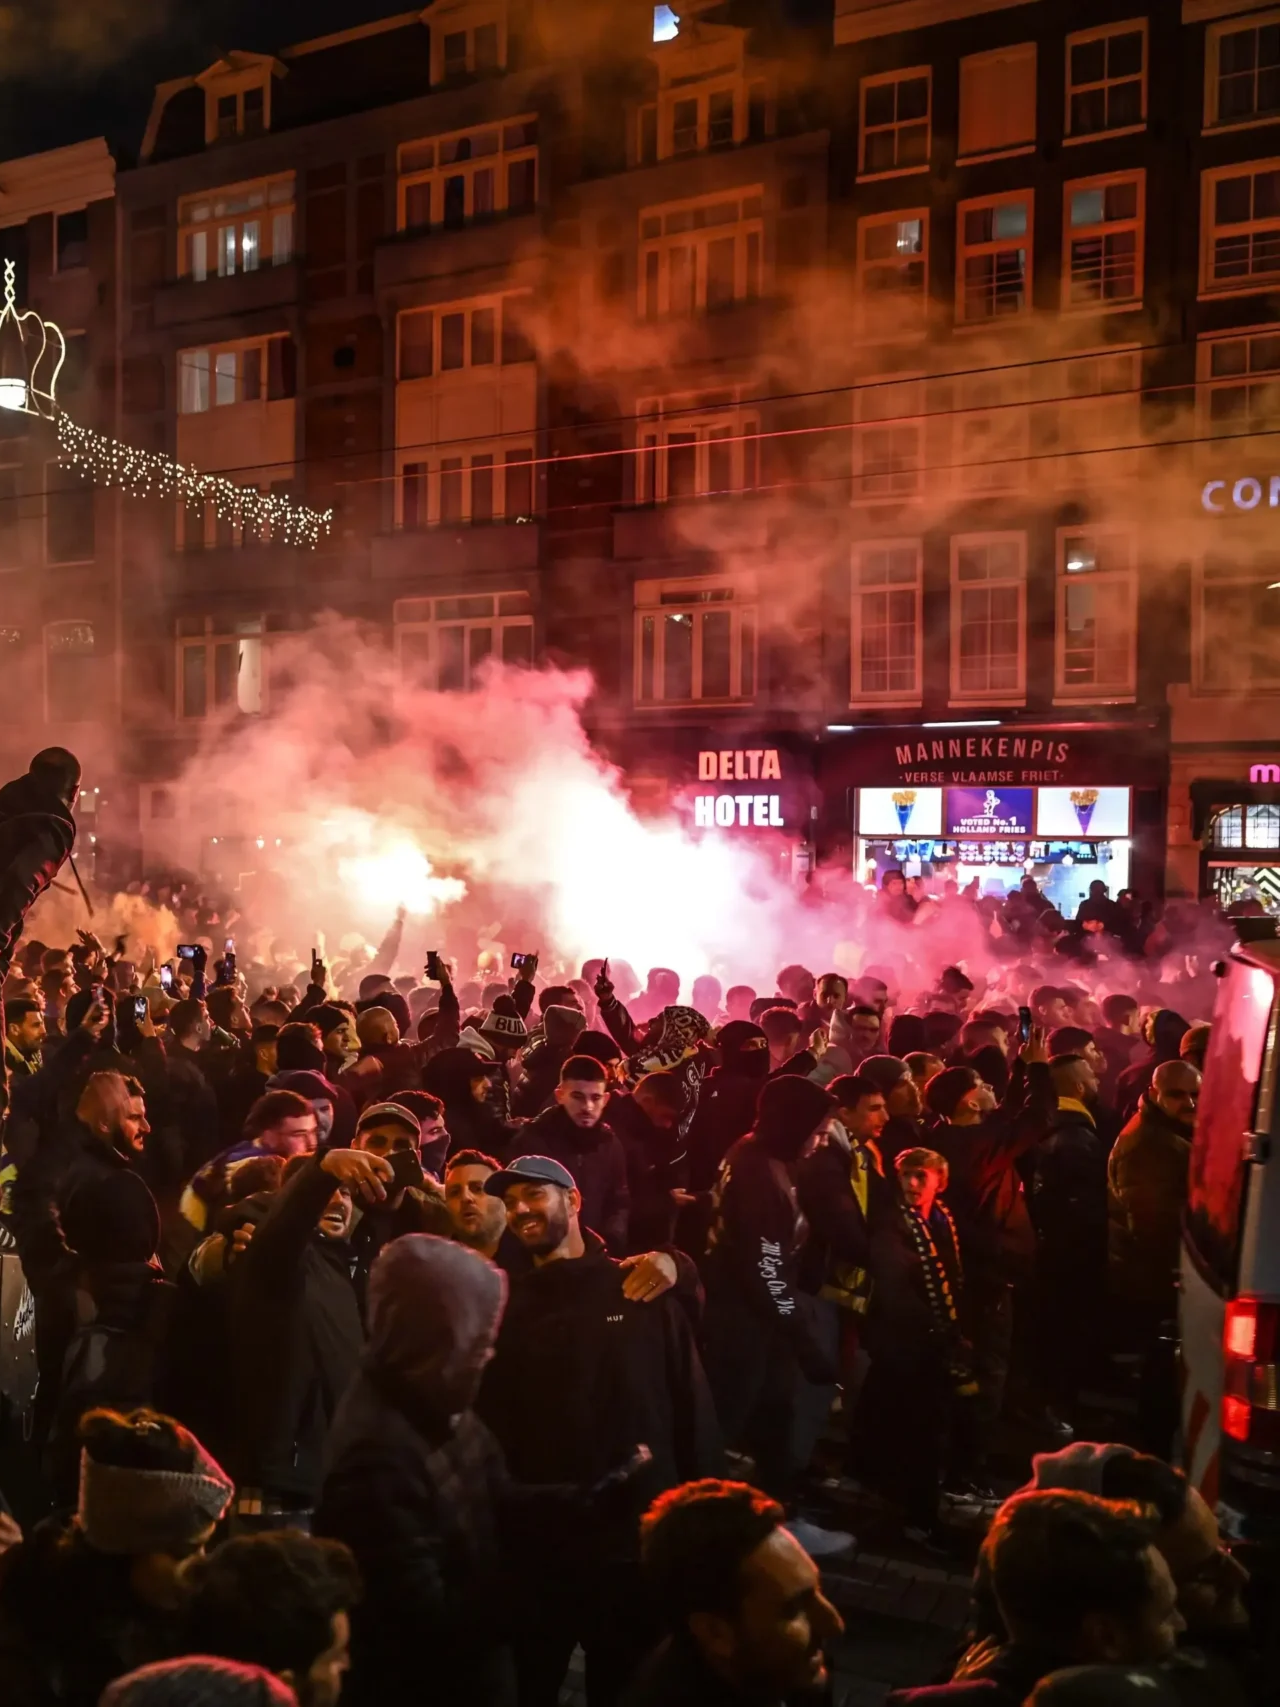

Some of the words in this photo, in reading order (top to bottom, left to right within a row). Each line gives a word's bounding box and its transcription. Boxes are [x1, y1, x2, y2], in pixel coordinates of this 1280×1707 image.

[895, 737, 1069, 765] MANNEKENPIS
[698, 749, 782, 781] DELTA
[904, 771, 945, 784] VERSE
[952, 770, 1014, 783] VLAAMSE
[1021, 769, 1060, 782] FRIET
[694, 794, 785, 827] HOTEL
[952, 825, 997, 834] HOLLAND
[998, 825, 1027, 834] FRIES
[960, 818, 991, 827] VOTED
[766, 1280, 787, 1296] On
[606, 1314, 624, 1323] HUF
